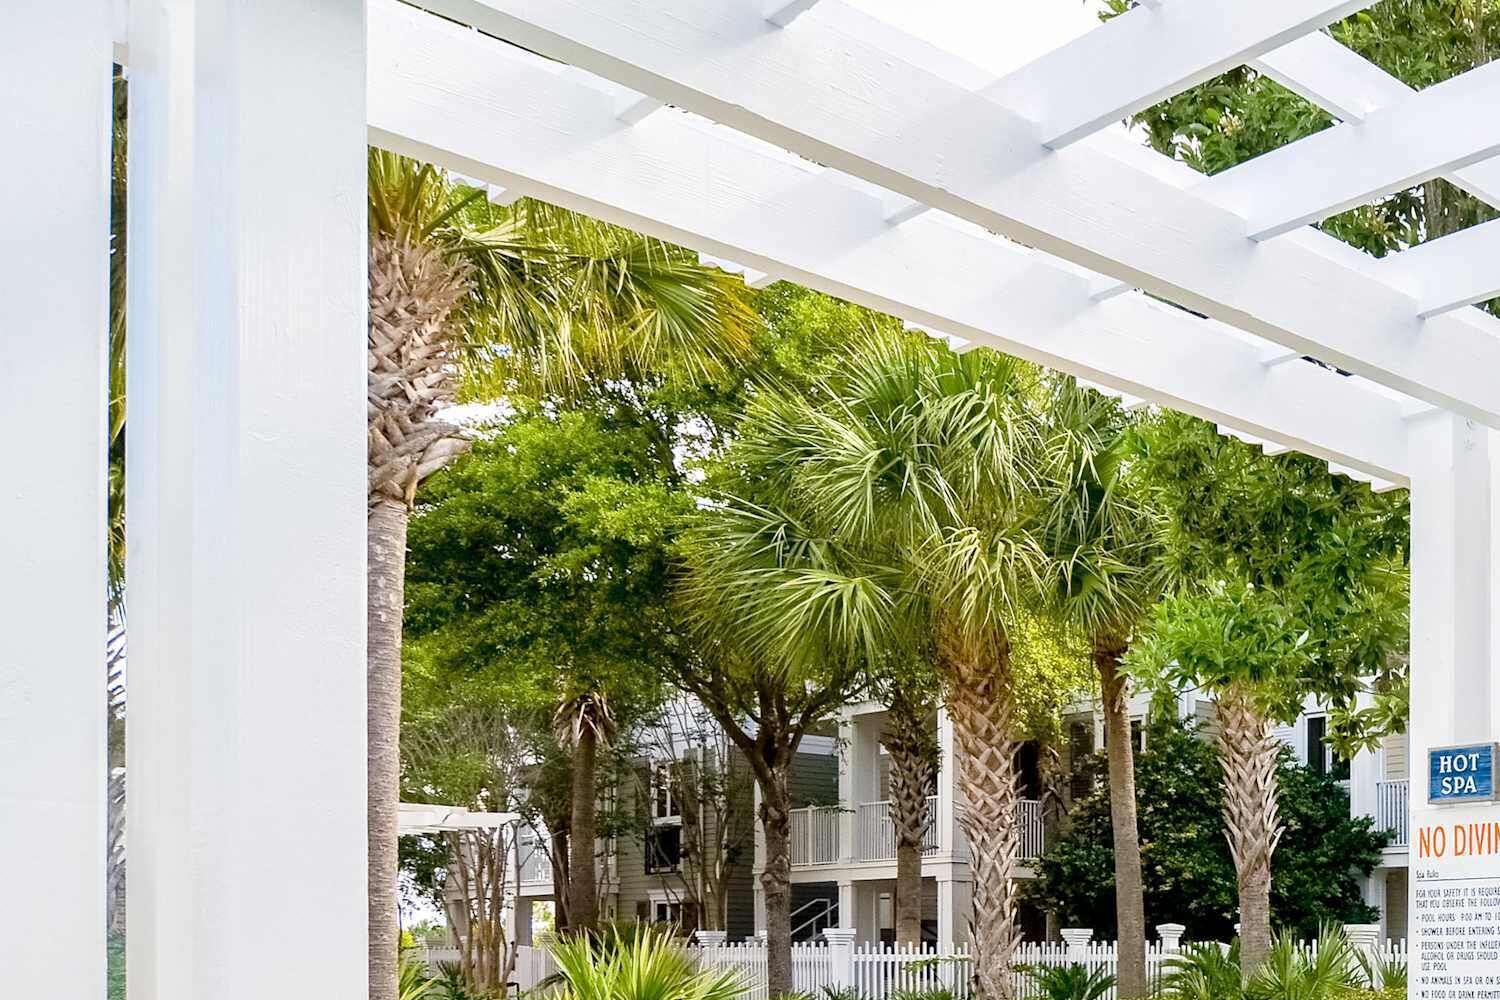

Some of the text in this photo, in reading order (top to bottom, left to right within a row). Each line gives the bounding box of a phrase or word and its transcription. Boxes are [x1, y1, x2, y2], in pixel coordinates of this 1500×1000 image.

[1440, 754, 1479, 773] HOT
[1441, 776, 1477, 794] SPA
[1419, 826, 1446, 858] NO
[1442, 899, 1464, 908] OBSERVE
[1468, 898, 1477, 907] THE
[1422, 928, 1443, 936] SHOWER
[1469, 926, 1495, 935] ENTERING
[1447, 941, 1464, 949] UNDER
[1467, 941, 1476, 949] THE
[1422, 952, 1444, 960] ALCOHOL
[1447, 952, 1454, 960] OR
[1457, 952, 1474, 960] DRUGS
[1477, 952, 1497, 960] SHOULD
[1433, 962, 1447, 971] POOL
